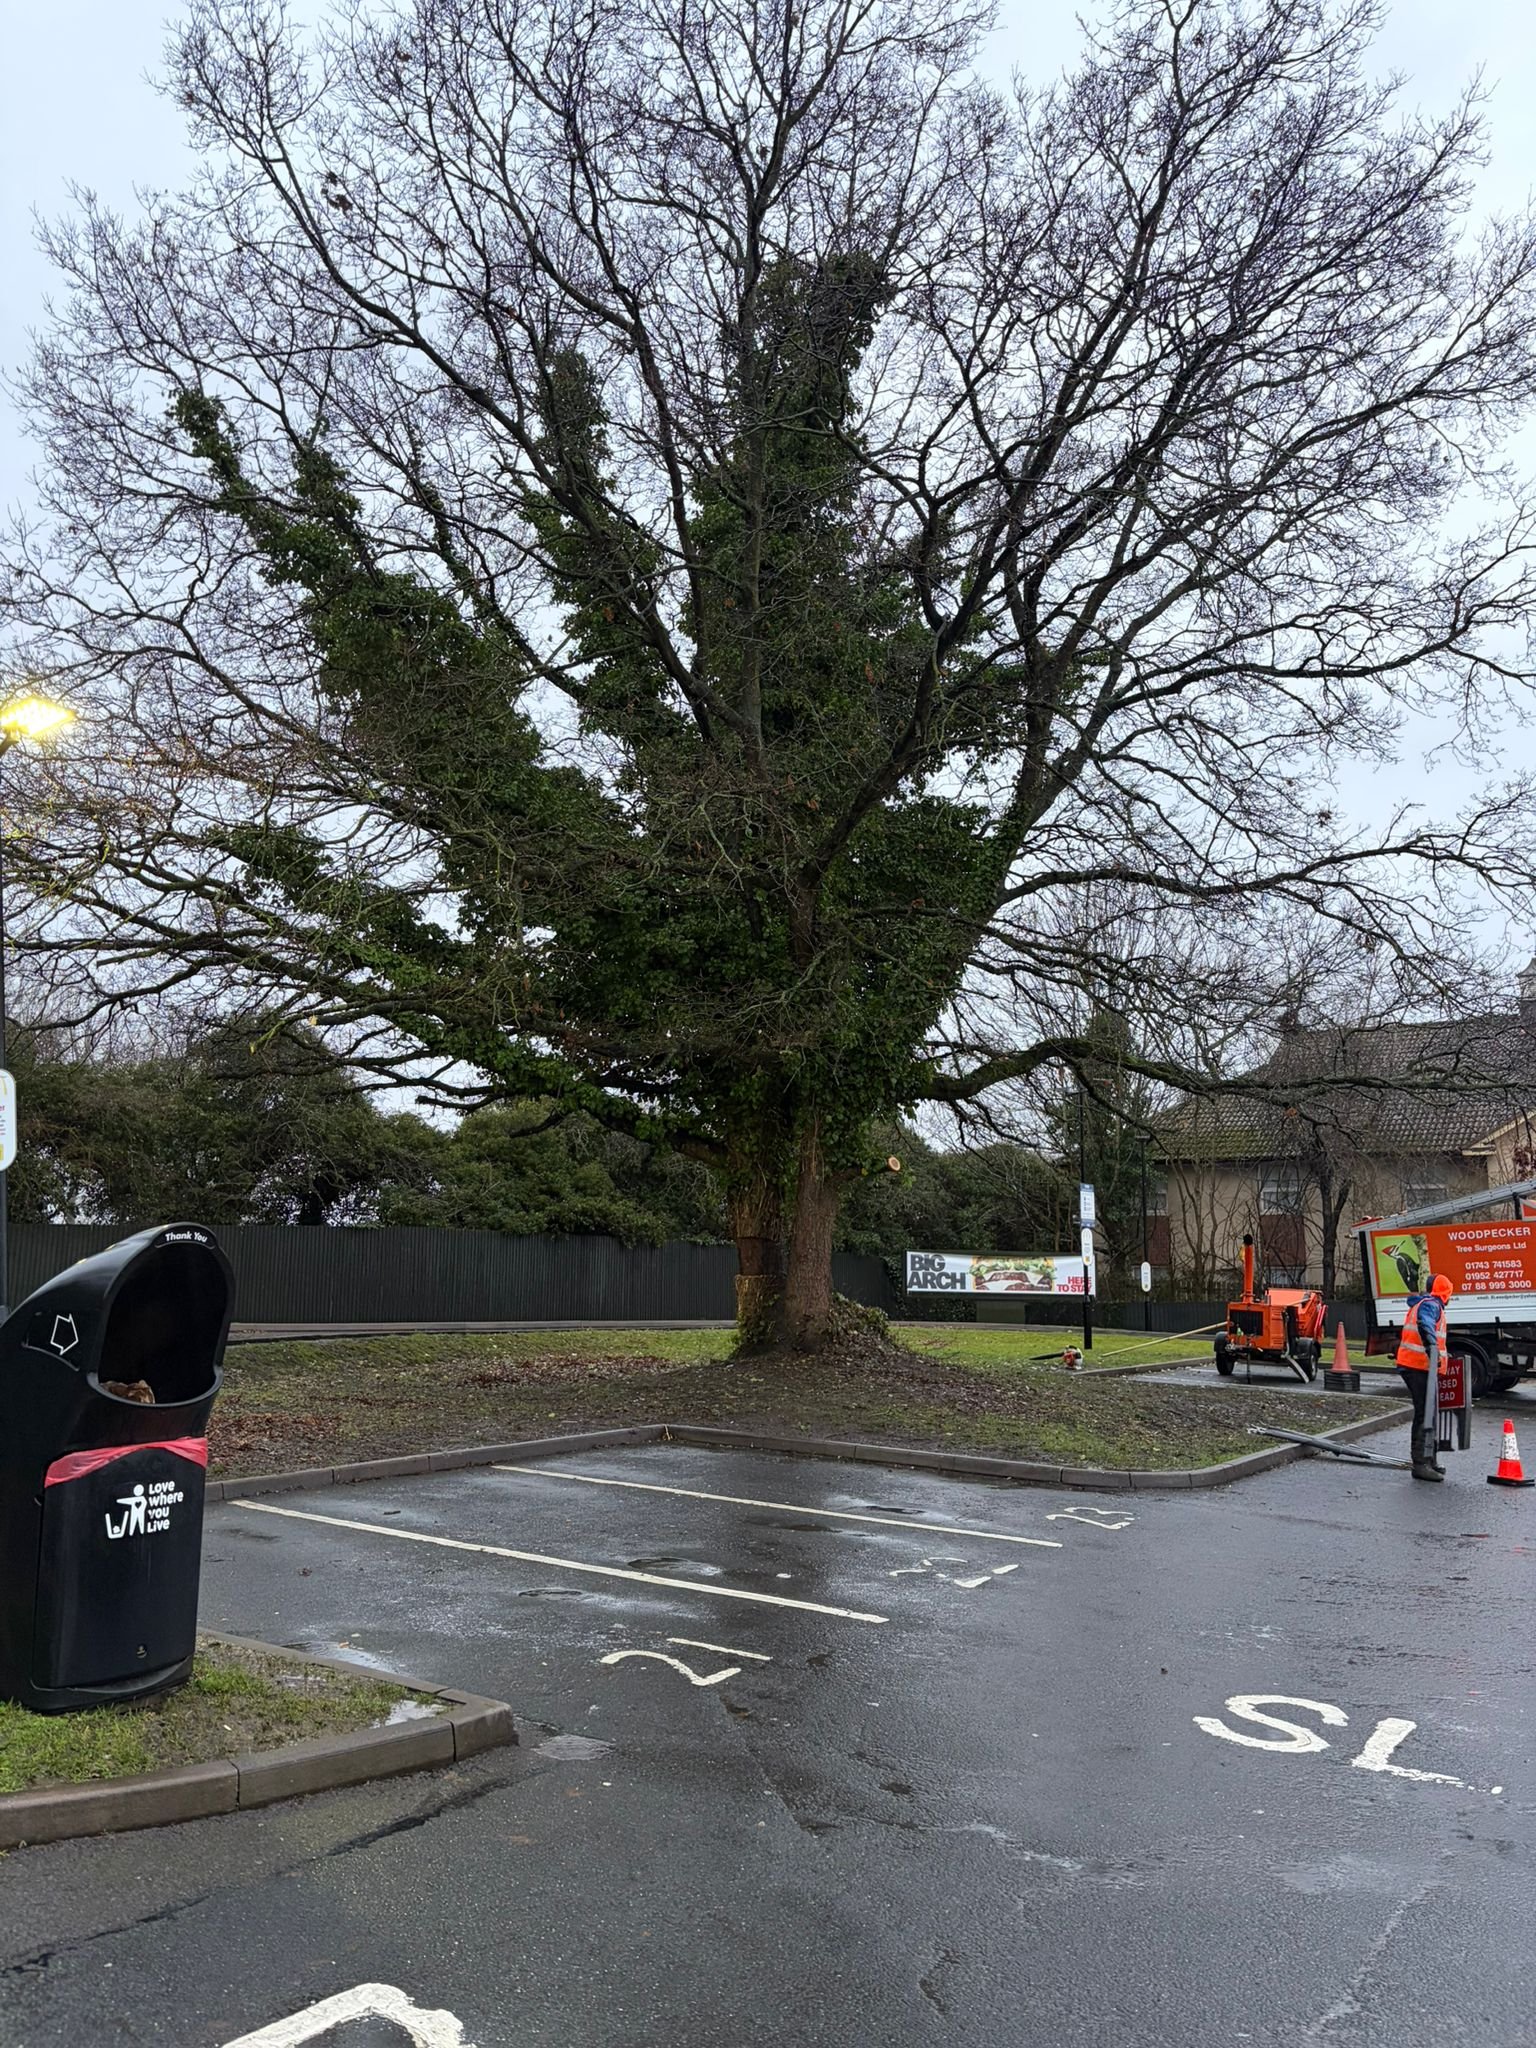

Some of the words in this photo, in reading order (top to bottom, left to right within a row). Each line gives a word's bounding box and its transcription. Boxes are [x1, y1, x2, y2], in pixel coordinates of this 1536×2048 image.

[165, 1231, 192, 1242] Thank
[194, 1231, 208, 1243] You
[1448, 1227, 1531, 1241] WOODPECKER
[1456, 1245, 1473, 1253] Tree
[1474, 1243, 1511, 1252] Surgeons
[1513, 1241, 1527, 1249] Ltd
[1465, 1261, 1490, 1270] 01743
[1492, 1260, 1522, 1269] 741583
[908, 1272, 966, 1290] ARCH
[1465, 1272, 1491, 1281] 01952
[1493, 1270, 1524, 1279] 427717
[1056, 1284, 1070, 1292] TO
[1462, 1283, 1472, 1291] 07
[1475, 1282, 1486, 1290] 88
[1489, 1281, 1506, 1289] 999
[1508, 1280, 1532, 1289] 3000
[149, 1492, 183, 1506] where
[600, 1637, 772, 1686] 21
